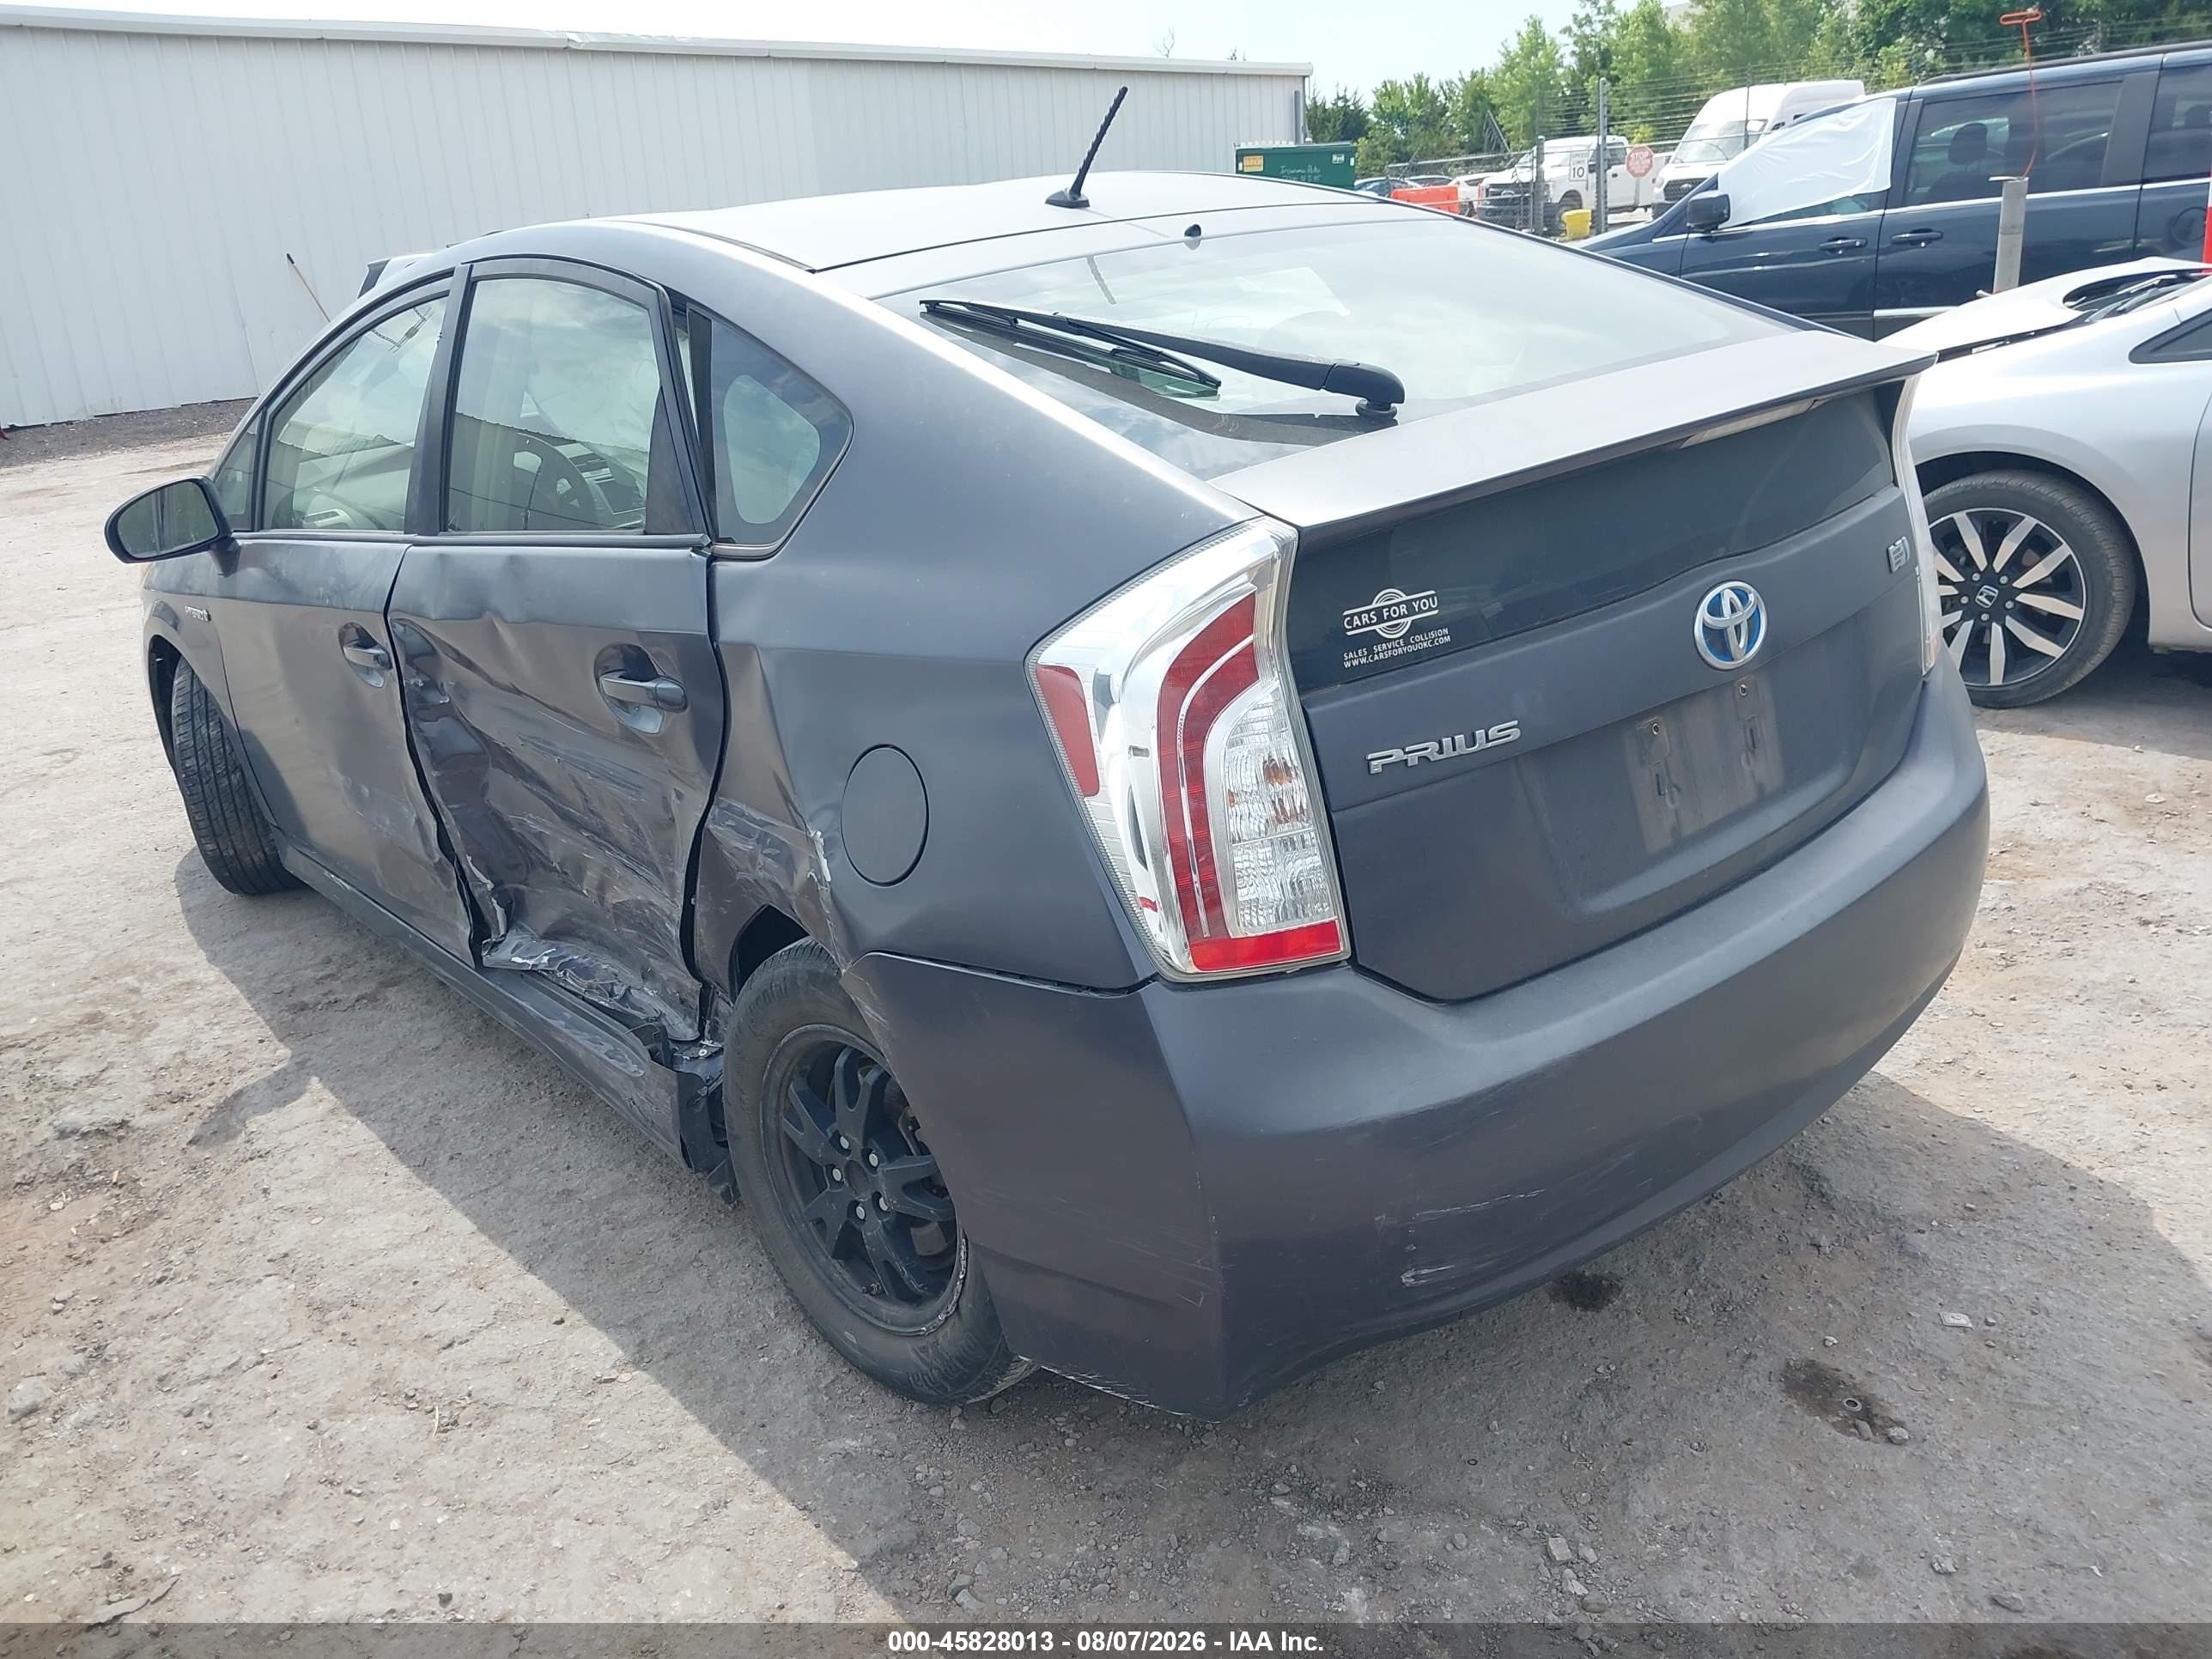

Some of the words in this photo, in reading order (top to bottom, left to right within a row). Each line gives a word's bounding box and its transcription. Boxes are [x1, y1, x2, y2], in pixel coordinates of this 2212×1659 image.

[1630, 151, 1650, 161] STOP
[1573, 167, 1585, 179] 10
[1343, 611, 1377, 629] CARS
[1383, 604, 1407, 620] FOR
[1413, 596, 1437, 613] YOU
[1343, 647, 1367, 660] SALES
[1373, 639, 1404, 653] SERVICE
[1410, 628, 1449, 643] COLLISION
[1343, 635, 1450, 668] WWW.CARSFORYOUOKC.COM
[1366, 720, 1522, 775] PRIUS
